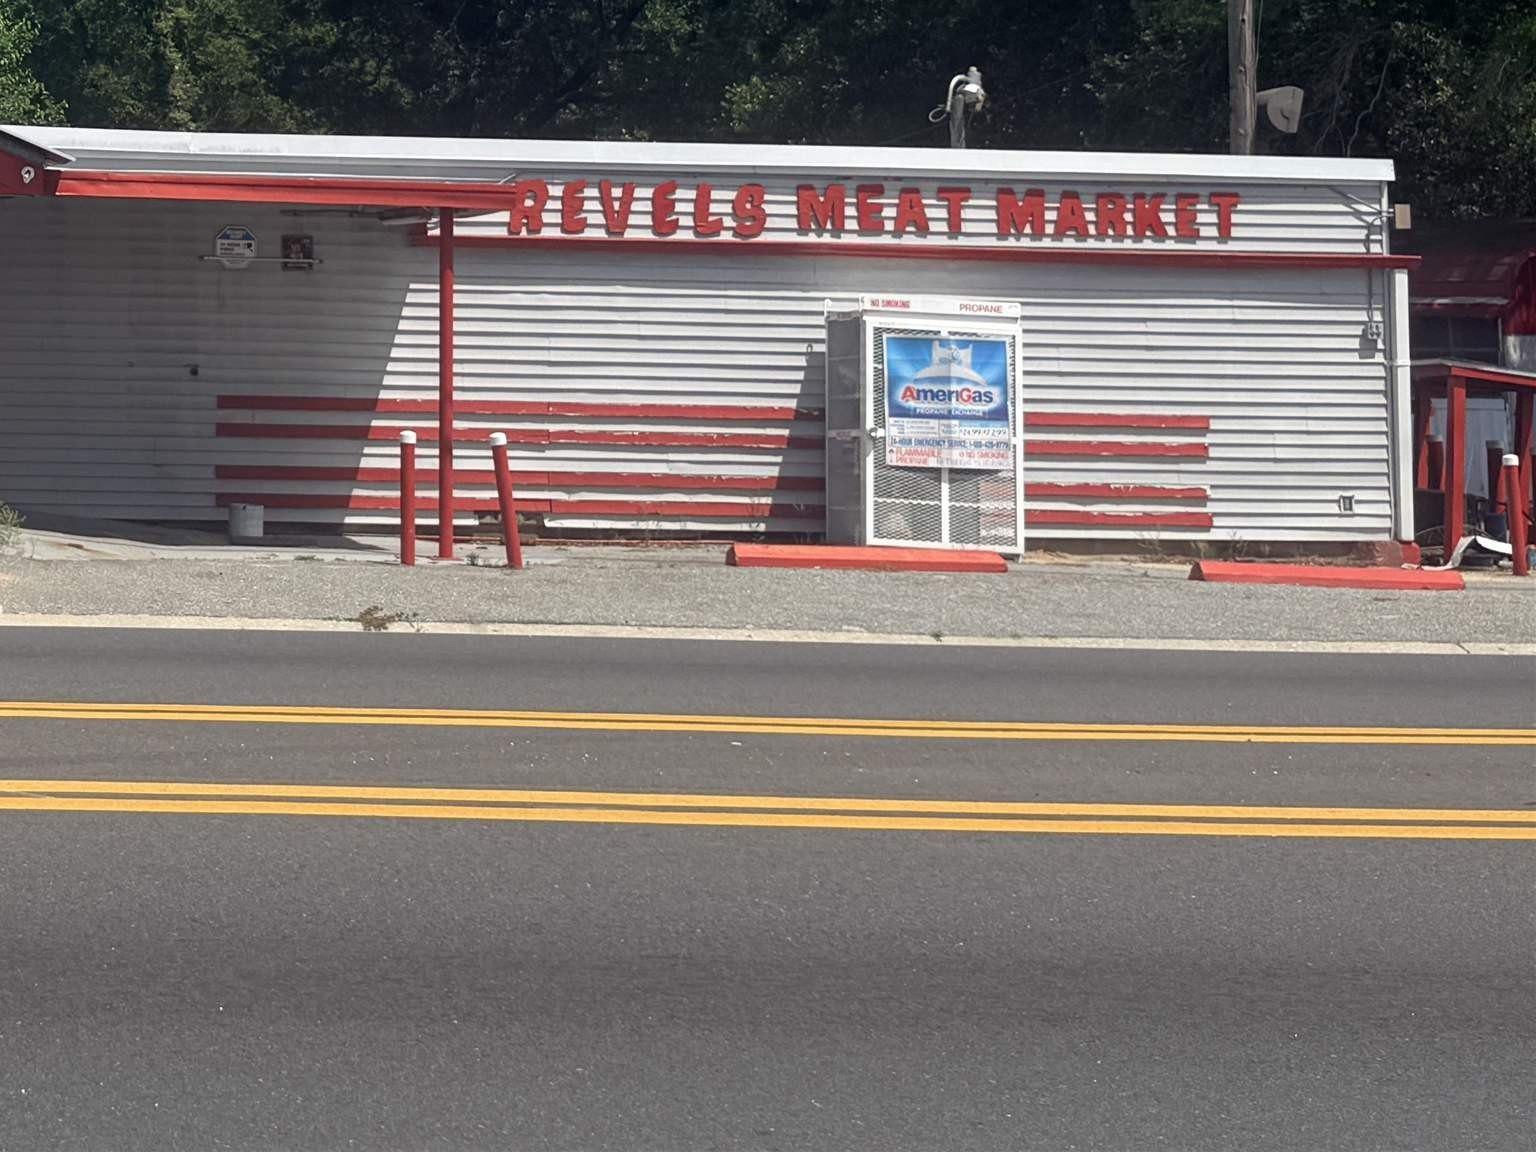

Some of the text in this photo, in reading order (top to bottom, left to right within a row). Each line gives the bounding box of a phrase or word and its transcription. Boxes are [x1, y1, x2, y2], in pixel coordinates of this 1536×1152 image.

[508, 178, 1240, 239] REVELS MEAT MARKET
[870, 298, 910, 309] NO SMOKING
[959, 303, 1003, 314] PROPANE
[901, 386, 994, 404] AmeriGas
[916, 407, 948, 415] PROPANE
